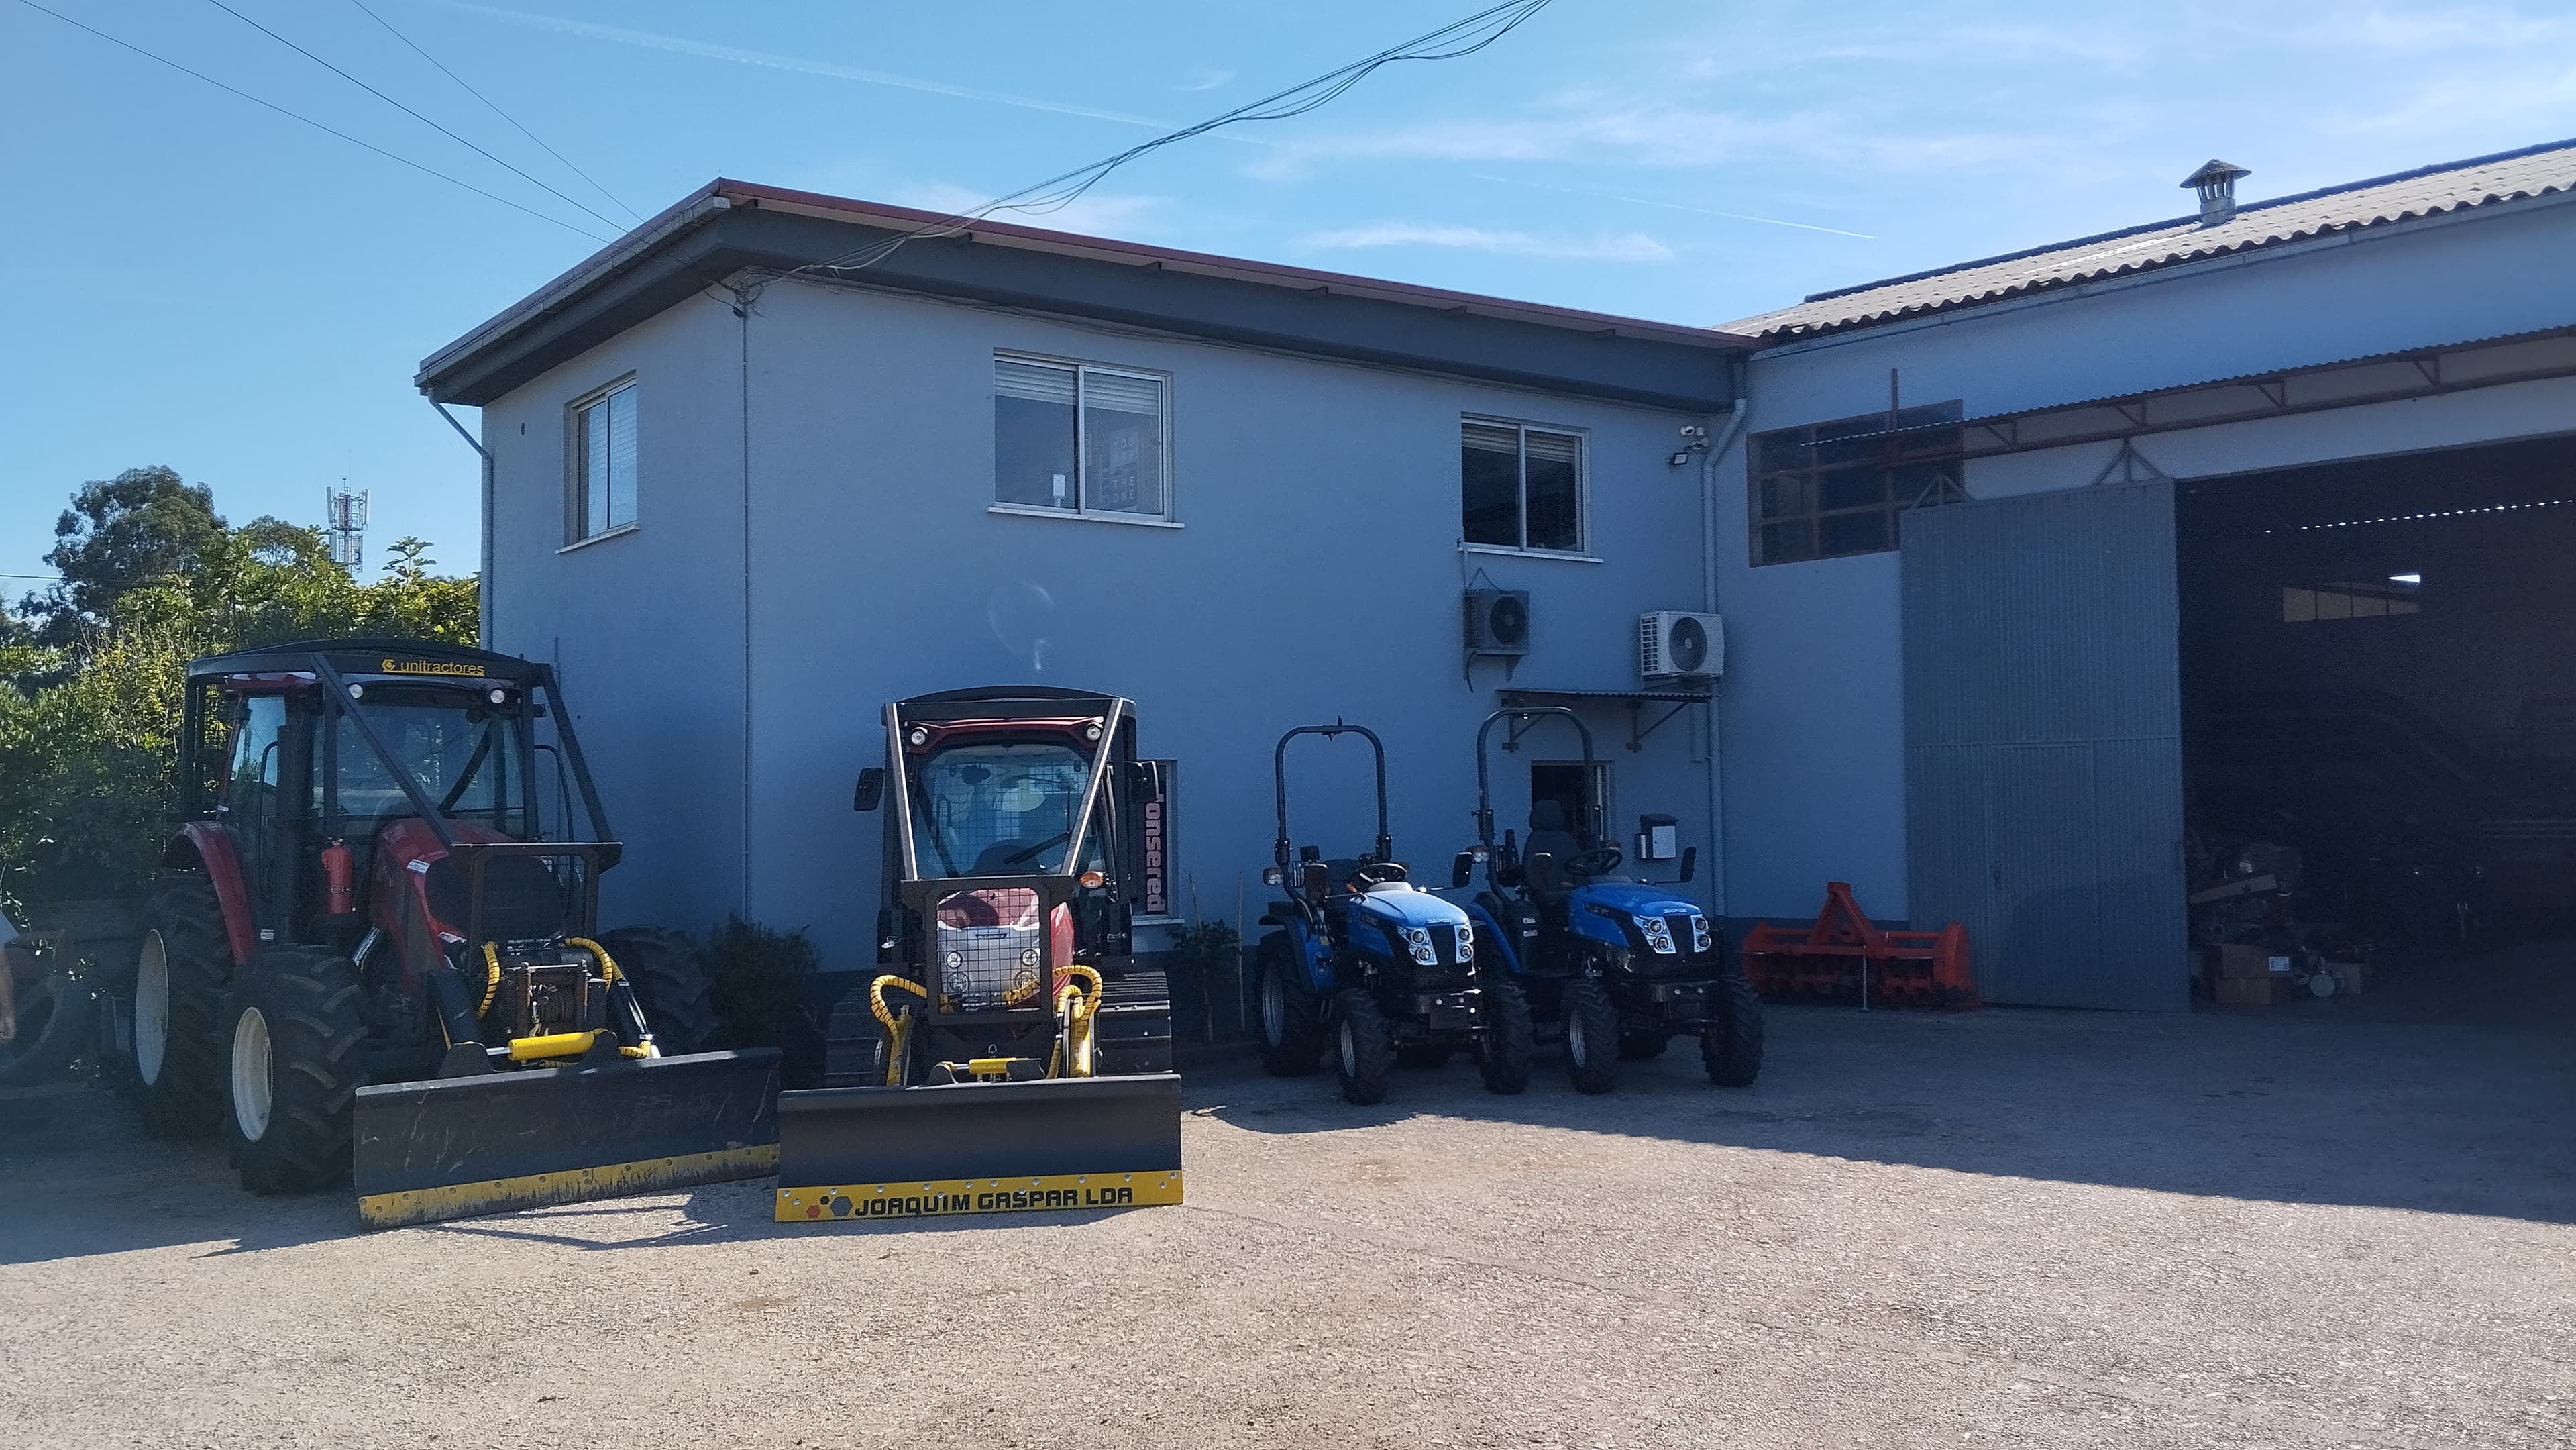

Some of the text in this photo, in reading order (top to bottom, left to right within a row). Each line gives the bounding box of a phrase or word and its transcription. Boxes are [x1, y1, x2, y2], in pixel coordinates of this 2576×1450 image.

[1112, 476, 1134, 488] THE
[1112, 489, 1134, 503] ONE
[400, 660, 484, 674] unitractores
[855, 1187, 1133, 1216] JOAQUIM GASPAR LDA
